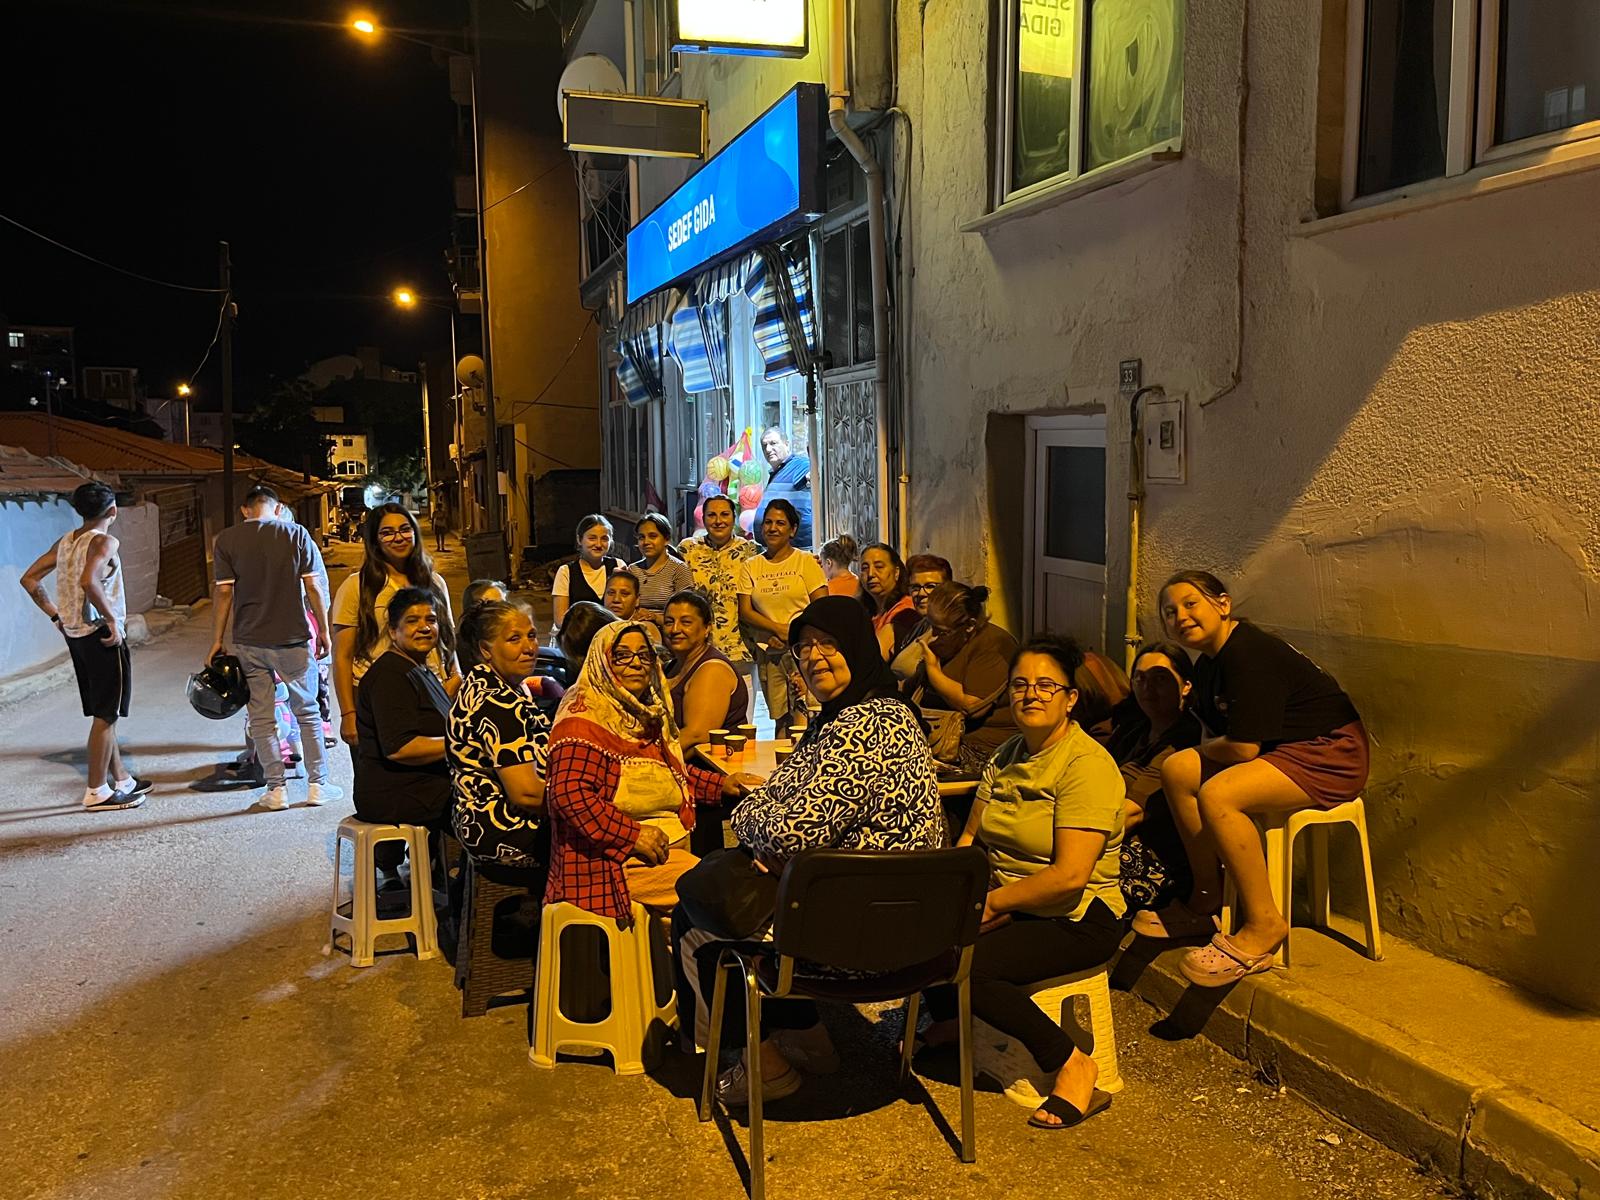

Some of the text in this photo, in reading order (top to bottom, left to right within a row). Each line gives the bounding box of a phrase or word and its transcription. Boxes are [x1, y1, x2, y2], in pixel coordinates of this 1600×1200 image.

[668, 193, 716, 253] SEDEF GIDA
[1124, 369, 1133, 383] 33
